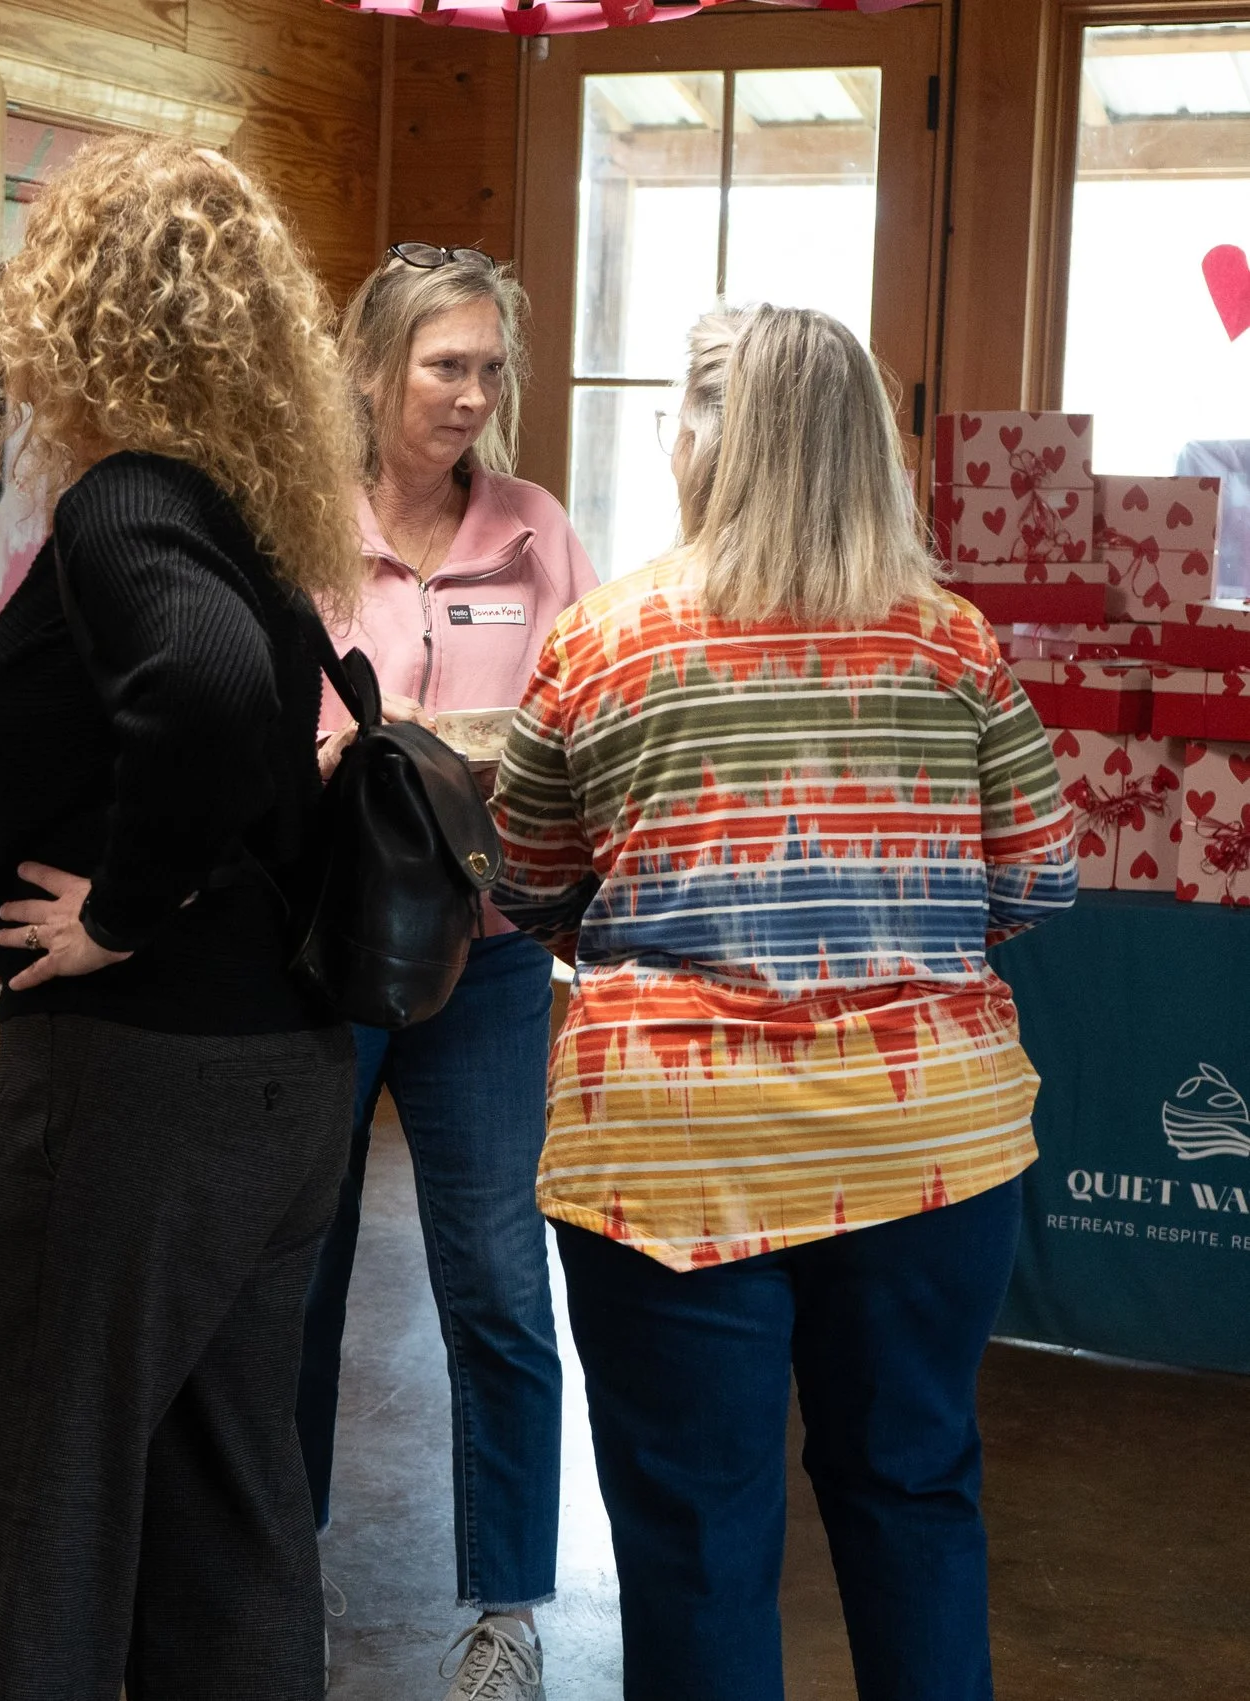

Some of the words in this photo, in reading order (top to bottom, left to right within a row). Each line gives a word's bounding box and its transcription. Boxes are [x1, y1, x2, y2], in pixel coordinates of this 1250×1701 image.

[450, 609, 469, 617] Hello
[470, 608, 500, 617] Donna
[1067, 1169, 1180, 1206] QUIET
[1190, 1182, 1250, 1214] WA
[1047, 1214, 1140, 1238] RETREATS.
[1146, 1224, 1224, 1247] RESPITE.
